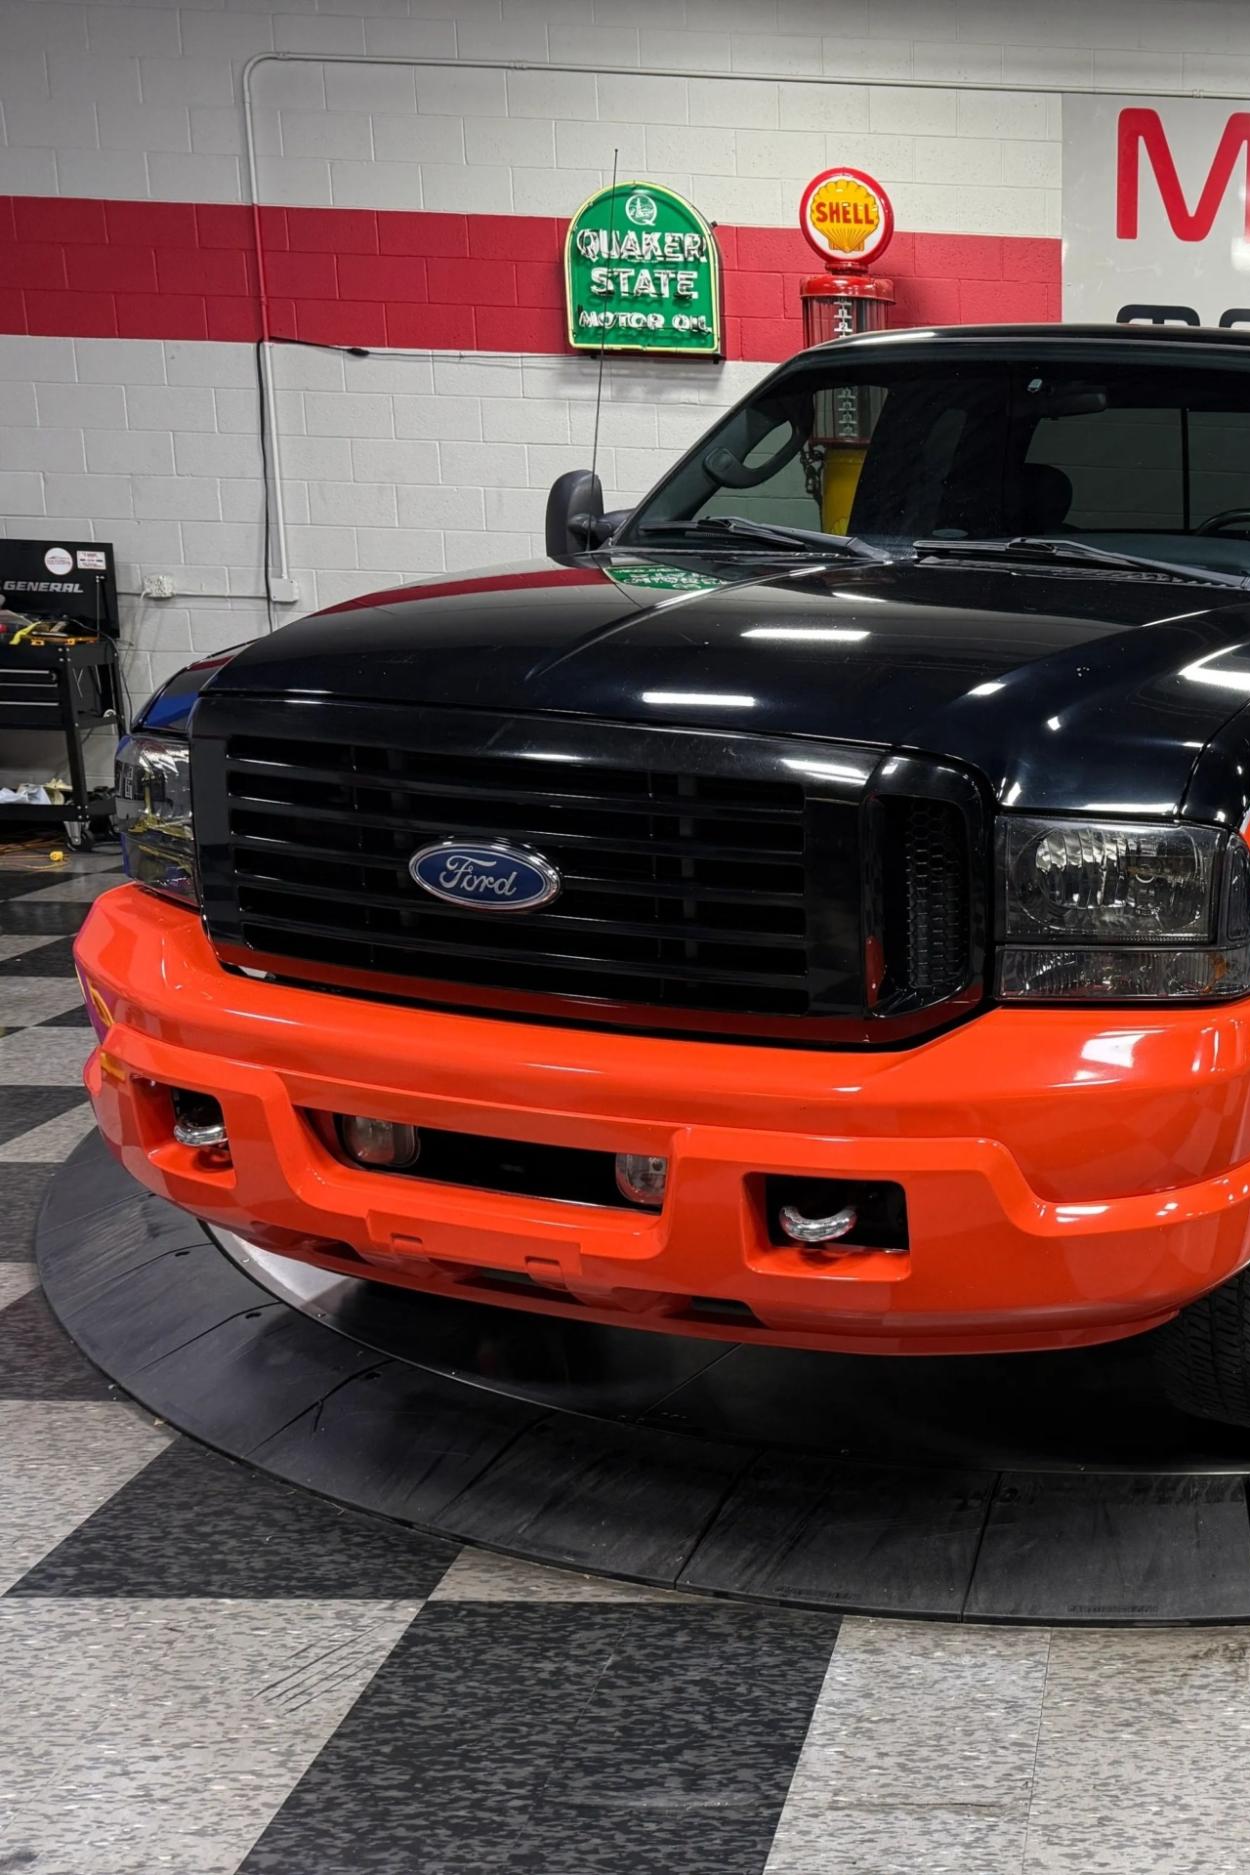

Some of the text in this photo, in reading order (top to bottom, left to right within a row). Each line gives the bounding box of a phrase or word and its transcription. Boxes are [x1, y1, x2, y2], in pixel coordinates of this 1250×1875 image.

[815, 201, 875, 225] SHELL
[577, 228, 708, 263] QUAKER
[590, 267, 699, 299] STATE
[579, 310, 713, 332] MOTOR OIL
[3, 581, 84, 593] GENERAL
[439, 855, 518, 896] Ford
